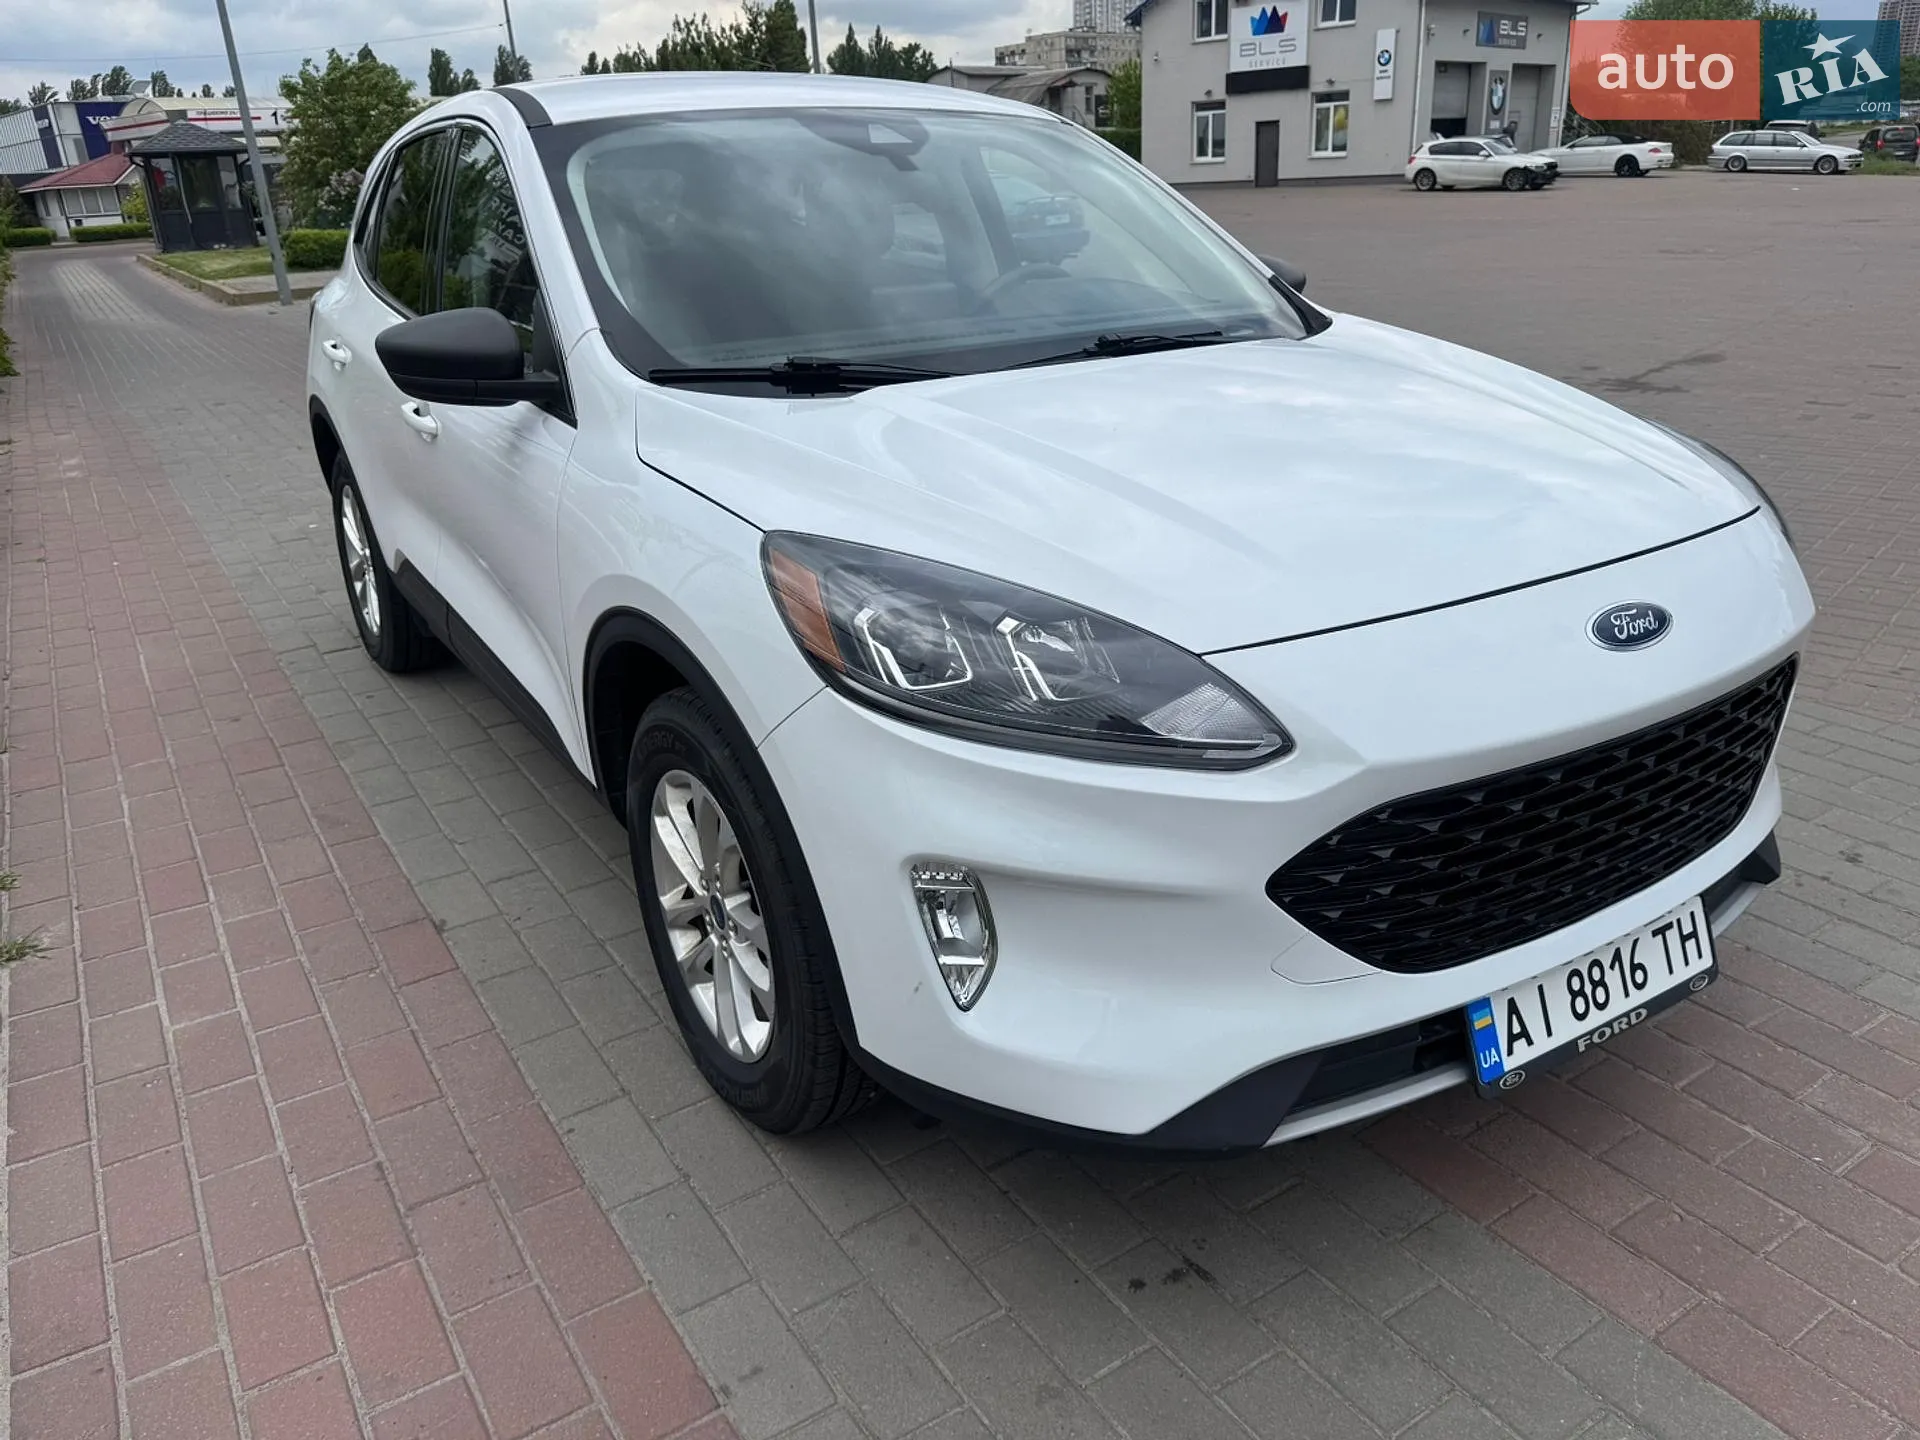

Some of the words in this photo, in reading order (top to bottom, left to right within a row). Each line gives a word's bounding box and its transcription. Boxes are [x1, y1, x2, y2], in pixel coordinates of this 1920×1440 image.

[1499, 19, 1528, 36] BLS
[1239, 38, 1297, 58] BLS
[1610, 607, 1659, 640] Ford
[1506, 982, 1553, 1058] AI
[1566, 937, 1649, 1022] 8816
[1651, 909, 1704, 976] TH
[1576, 1006, 1649, 1053] FORD
[1479, 1048, 1501, 1069] UA
